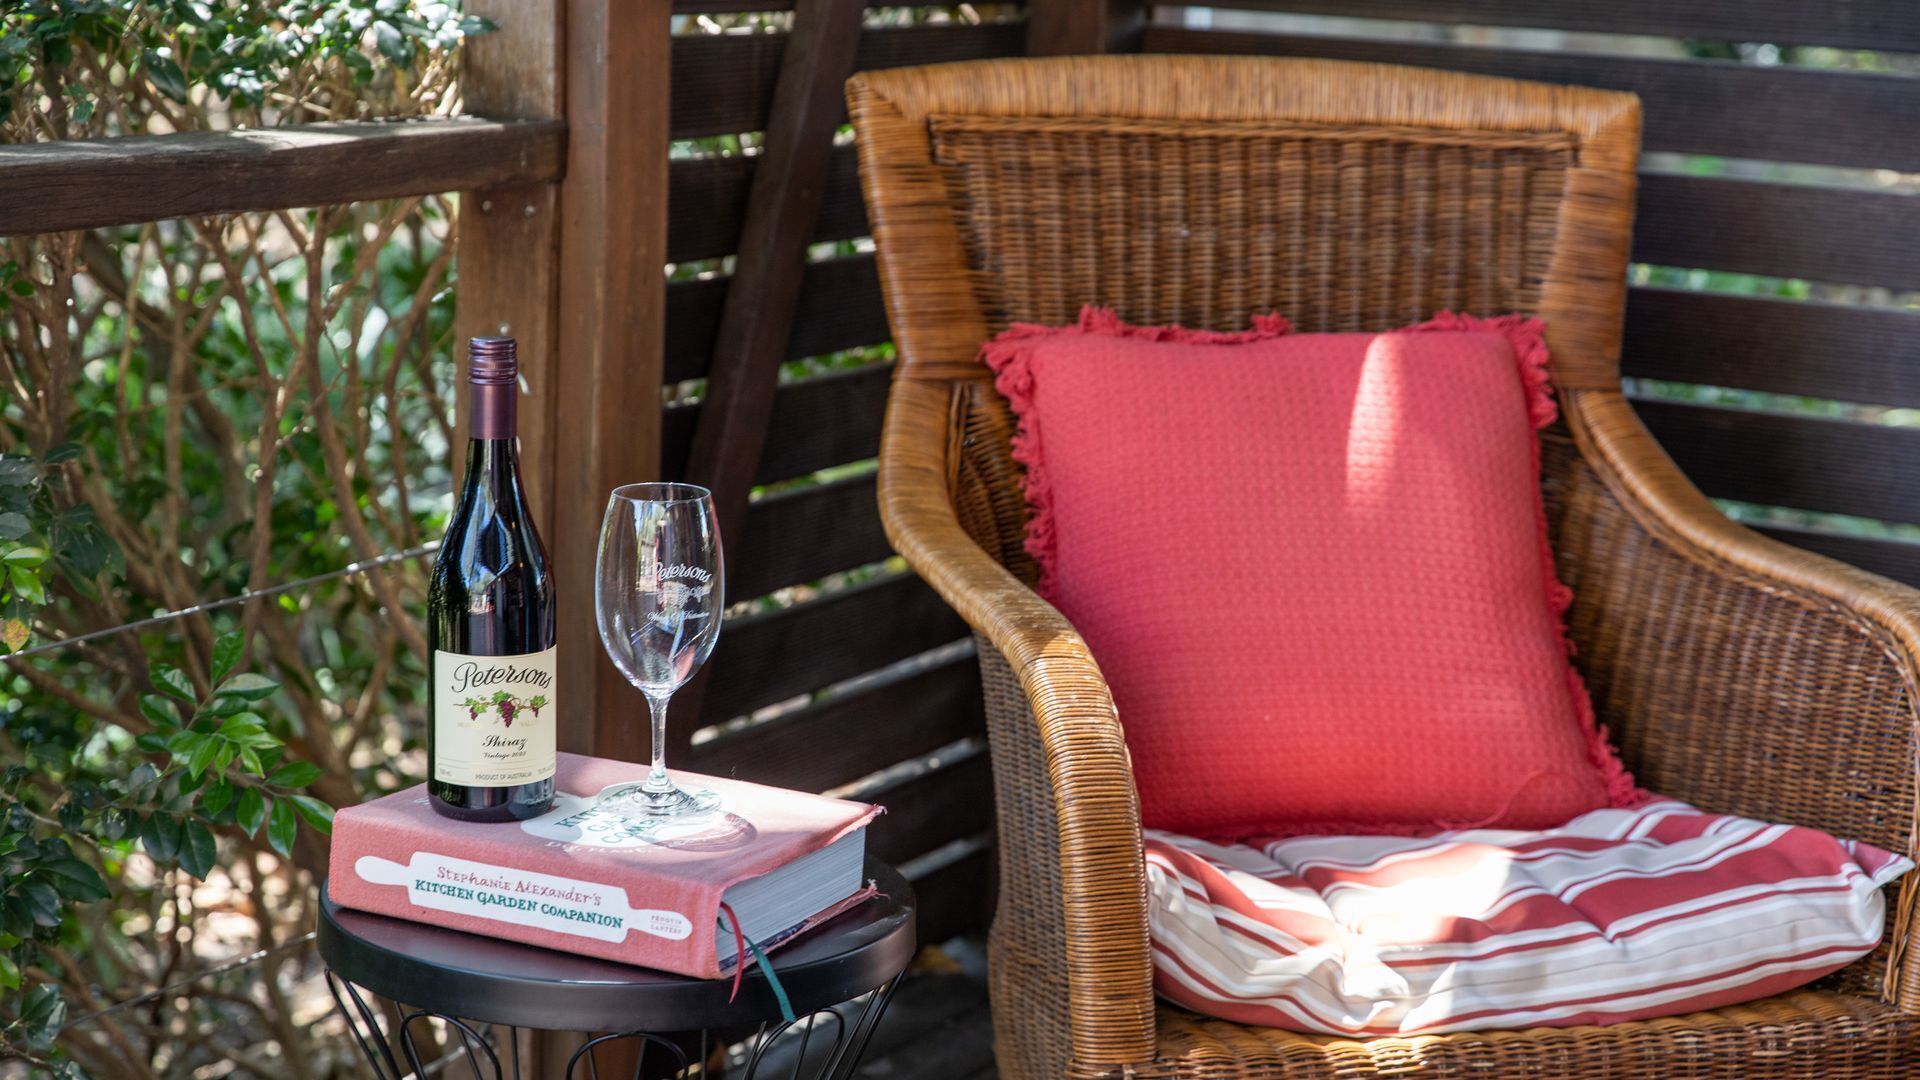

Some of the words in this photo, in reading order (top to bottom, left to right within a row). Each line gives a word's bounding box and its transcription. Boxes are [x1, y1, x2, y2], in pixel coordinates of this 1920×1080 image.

[654, 561, 712, 583] Petersons
[451, 661, 553, 693] Petersons
[482, 734, 527, 751] Shiraz
[507, 771, 533, 780] AUSTRALIA
[415, 879, 474, 901] KITCHEN
[476, 891, 538, 912] GARDEN
[541, 903, 623, 929] COMPANION
